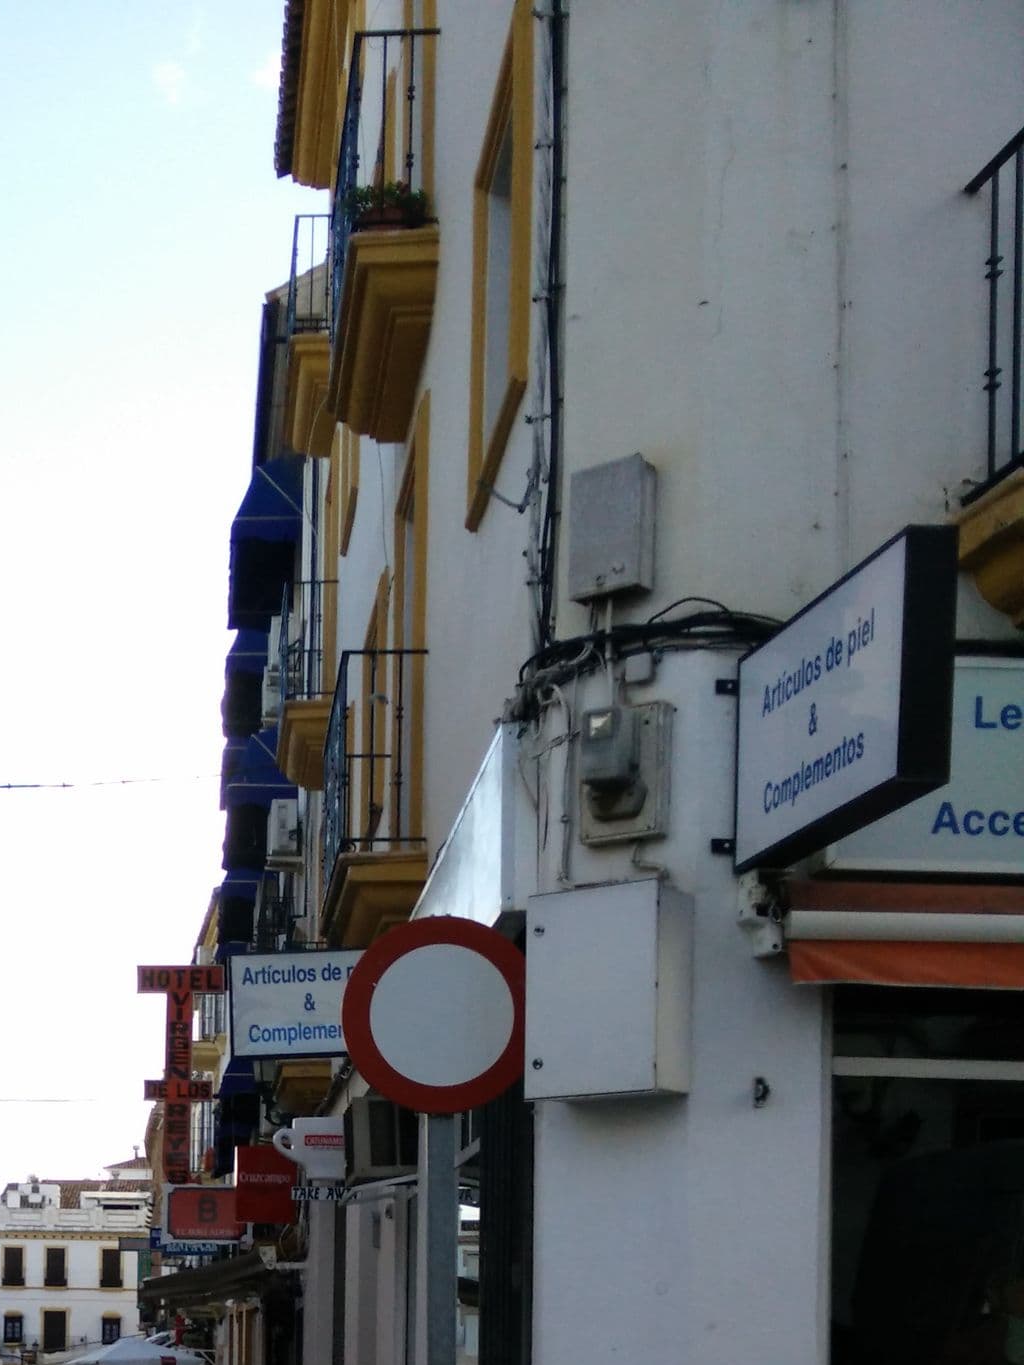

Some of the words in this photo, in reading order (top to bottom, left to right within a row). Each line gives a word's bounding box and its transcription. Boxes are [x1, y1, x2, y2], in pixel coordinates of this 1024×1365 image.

[762, 655, 822, 717] Artículos
[826, 637, 843, 671] de
[847, 608, 875, 667] piel
[808, 702, 818, 736] &
[763, 731, 865, 814] Complementos
[142, 968, 221, 990] HOTEL
[242, 963, 317, 985] Artículos
[321, 963, 342, 981] de
[303, 993, 316, 1011] &
[169, 992, 190, 1080] VIRGEN
[248, 1023, 343, 1046] Compleme
[146, 1084, 167, 1099] DE
[177, 1083, 210, 1098] LOS
[167, 1103, 188, 1184] REYES
[239, 1172, 290, 1184] Cruzcampo
[293, 1187, 320, 1200] TAKE
